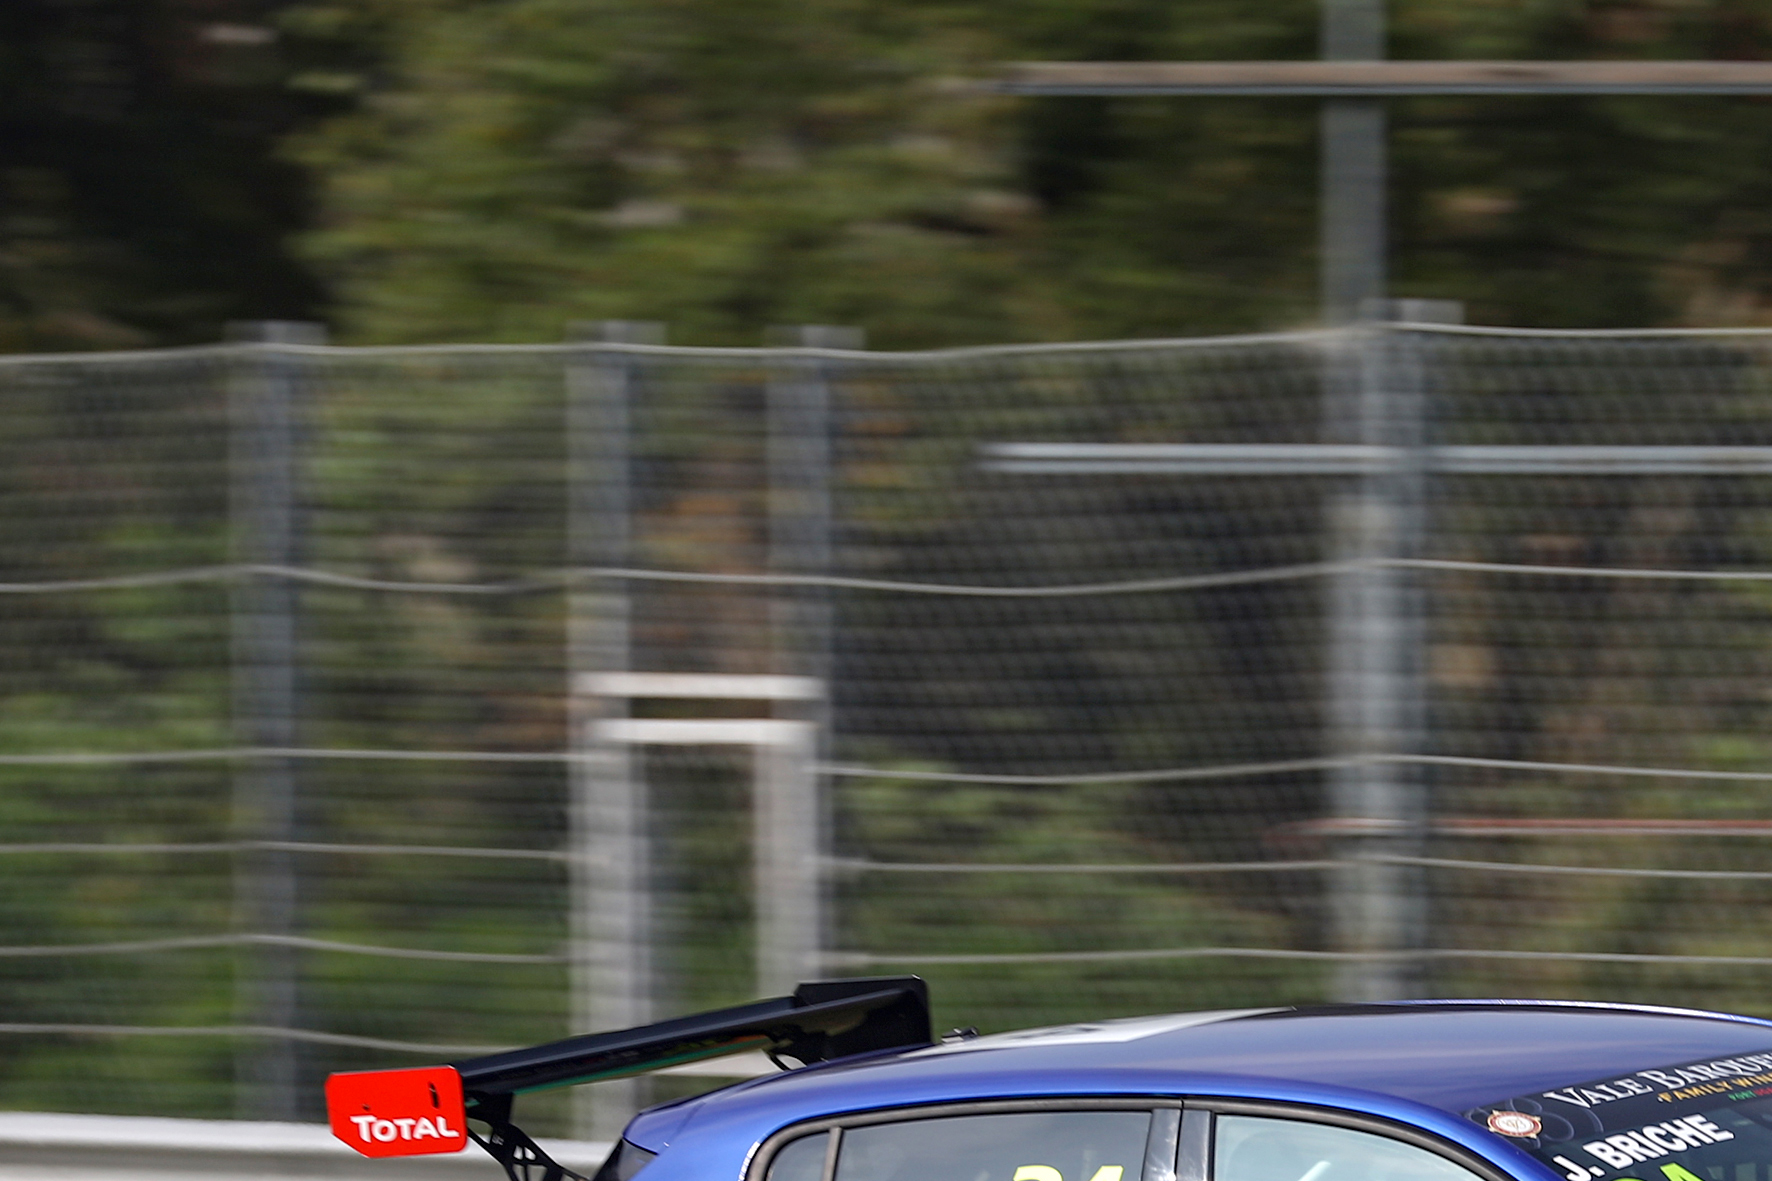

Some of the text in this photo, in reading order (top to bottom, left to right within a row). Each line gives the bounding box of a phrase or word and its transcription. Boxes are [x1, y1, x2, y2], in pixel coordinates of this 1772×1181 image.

[1543, 1071, 1655, 1110] VALE
[349, 1114, 460, 1143] TOTAL
[1582, 1113, 1735, 1171] BRICHE
